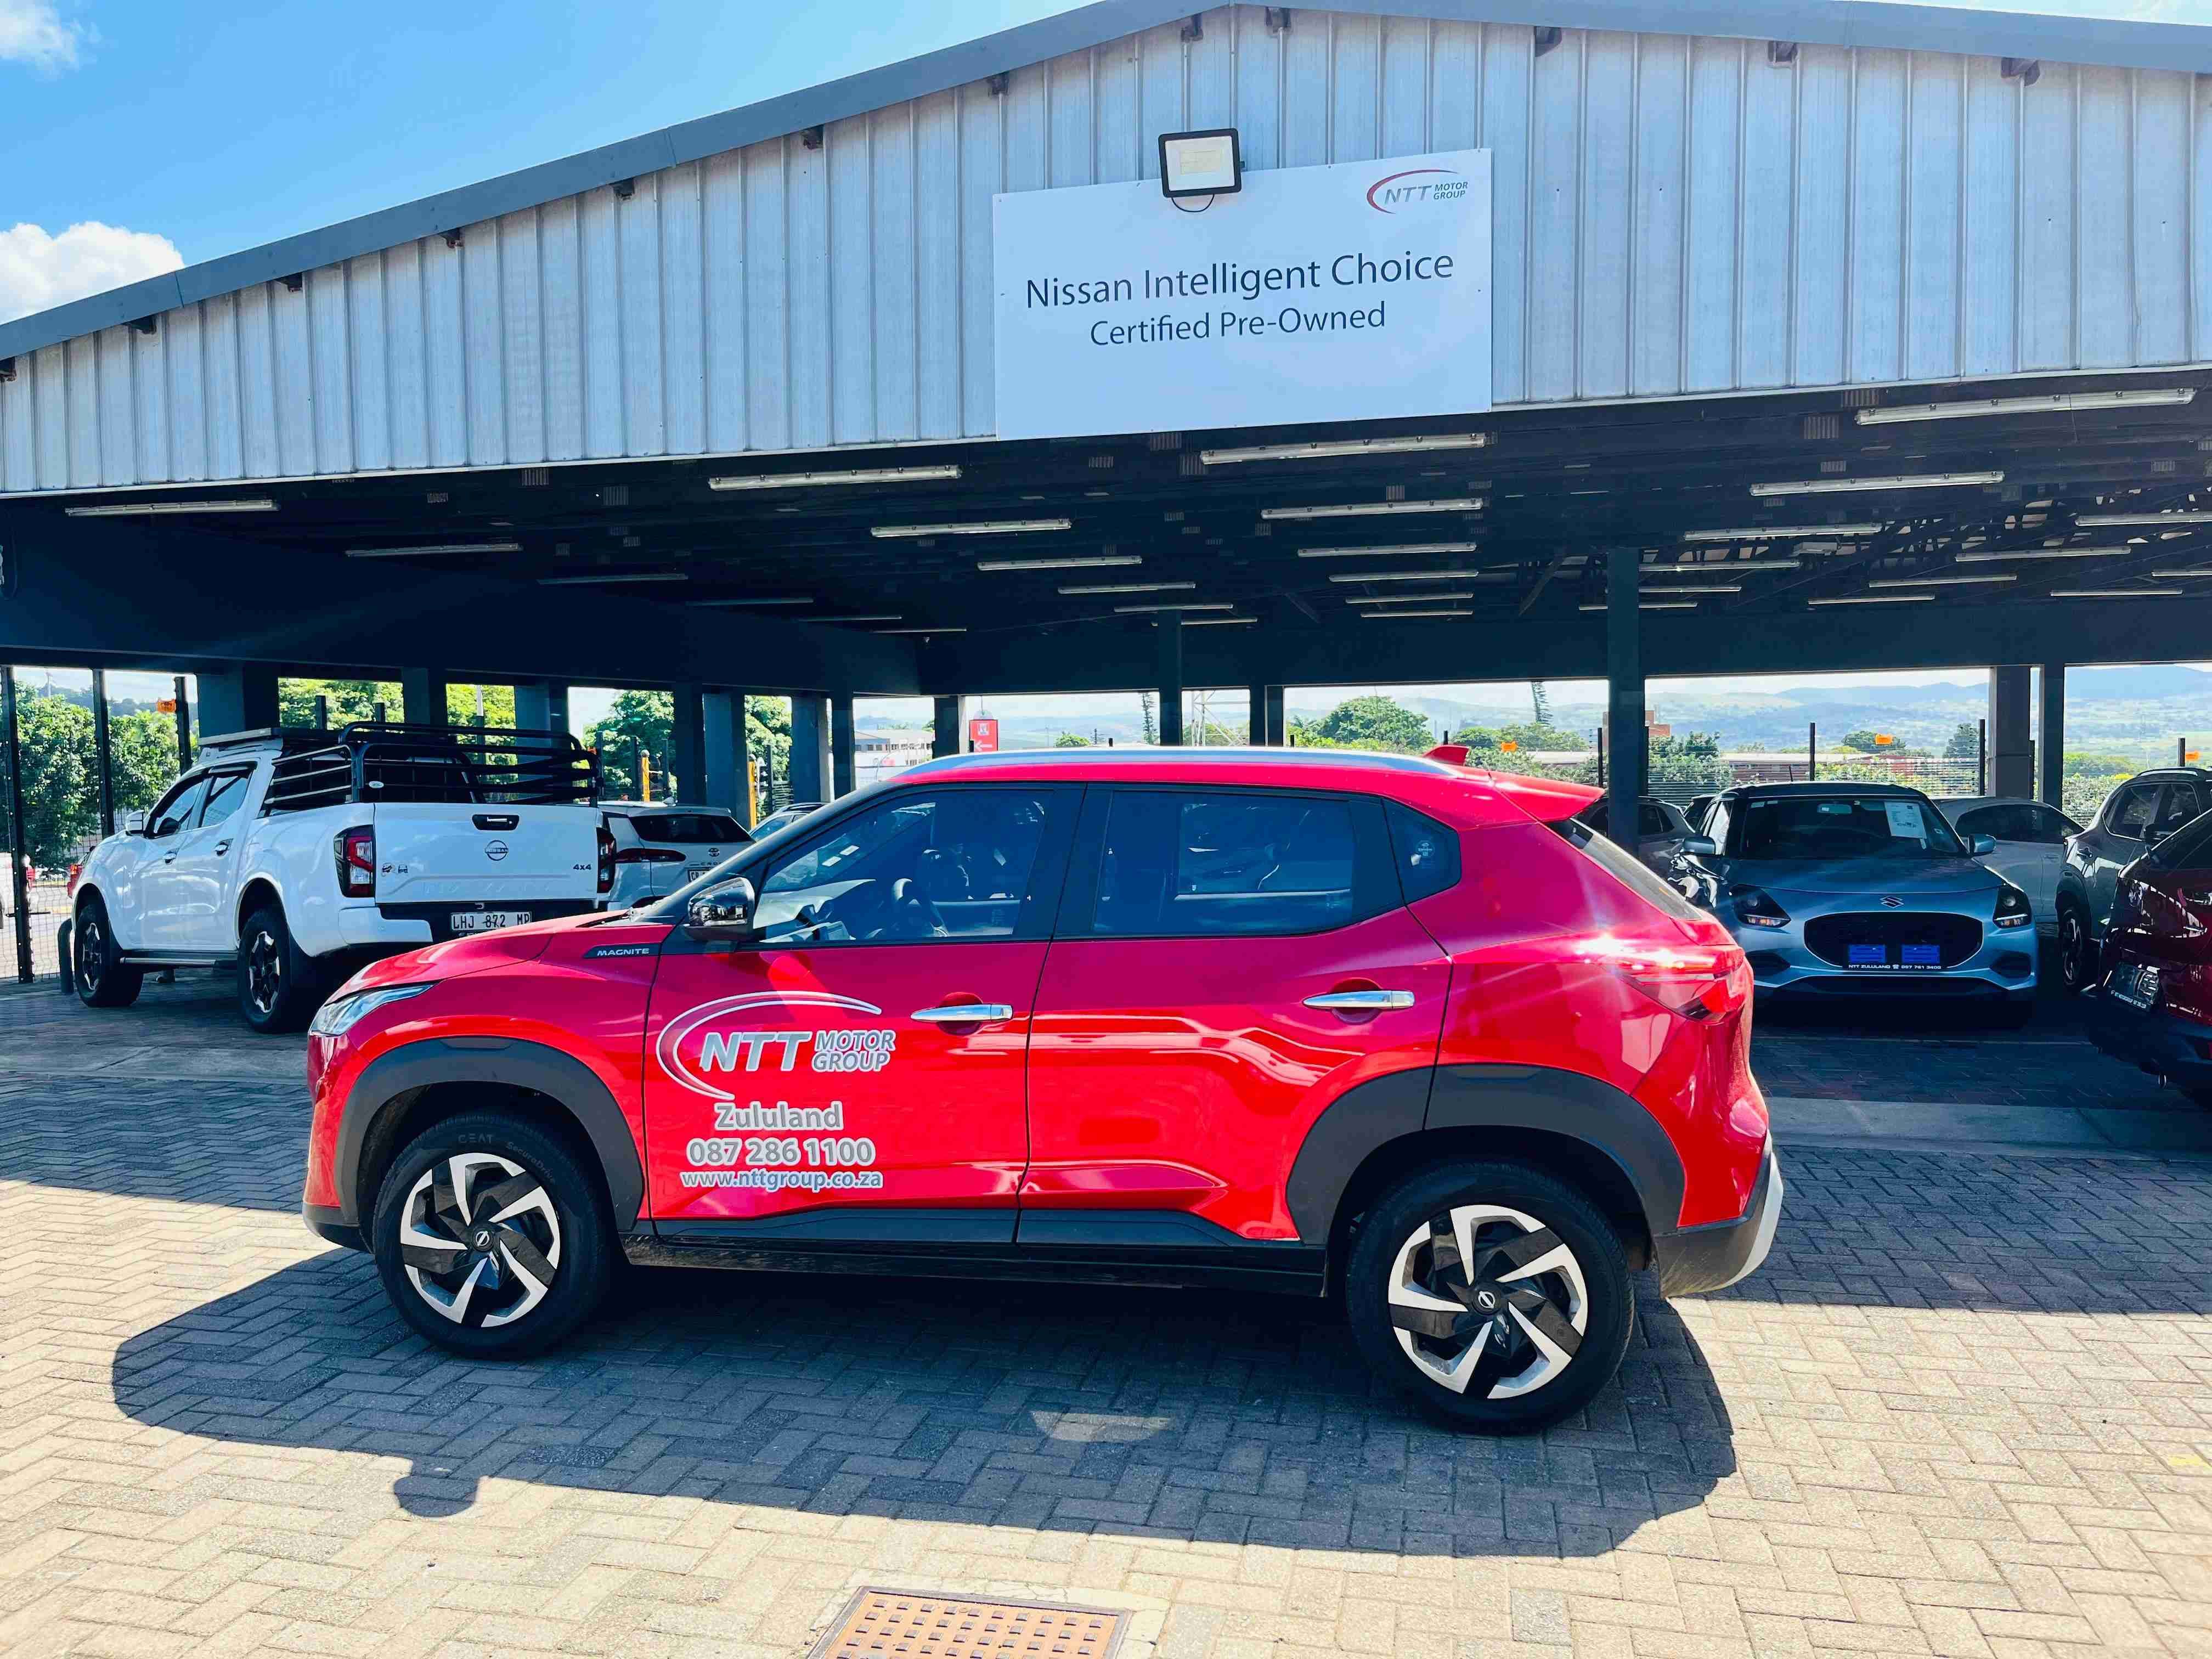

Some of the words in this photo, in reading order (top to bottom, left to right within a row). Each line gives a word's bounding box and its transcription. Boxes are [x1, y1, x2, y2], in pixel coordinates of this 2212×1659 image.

[1385, 185, 1432, 205] NTT
[1435, 182, 1468, 192] MOTOR
[1434, 190, 1466, 200] GROUP
[1026, 275, 1132, 308] Nissan
[1144, 259, 1321, 300] Intelligent
[1331, 250, 1454, 286] Choice
[1091, 312, 1211, 346] Certified
[1221, 301, 1386, 338] Pre-Owned
[453, 916, 474, 929] LHJ
[485, 915, 506, 928] 872
[596, 948, 650, 956] MAGNITE
[699, 1031, 811, 1071] NTT
[813, 1029, 895, 1052] MOTOR
[811, 1051, 890, 1073] GROUP
[714, 1101, 843, 1130] Zululand
[687, 1138, 744, 1166] 087
[745, 1137, 802, 1165] 286
[803, 1137, 876, 1166] 1100
[680, 1170, 883, 1193] www.nttgroup.co.za
